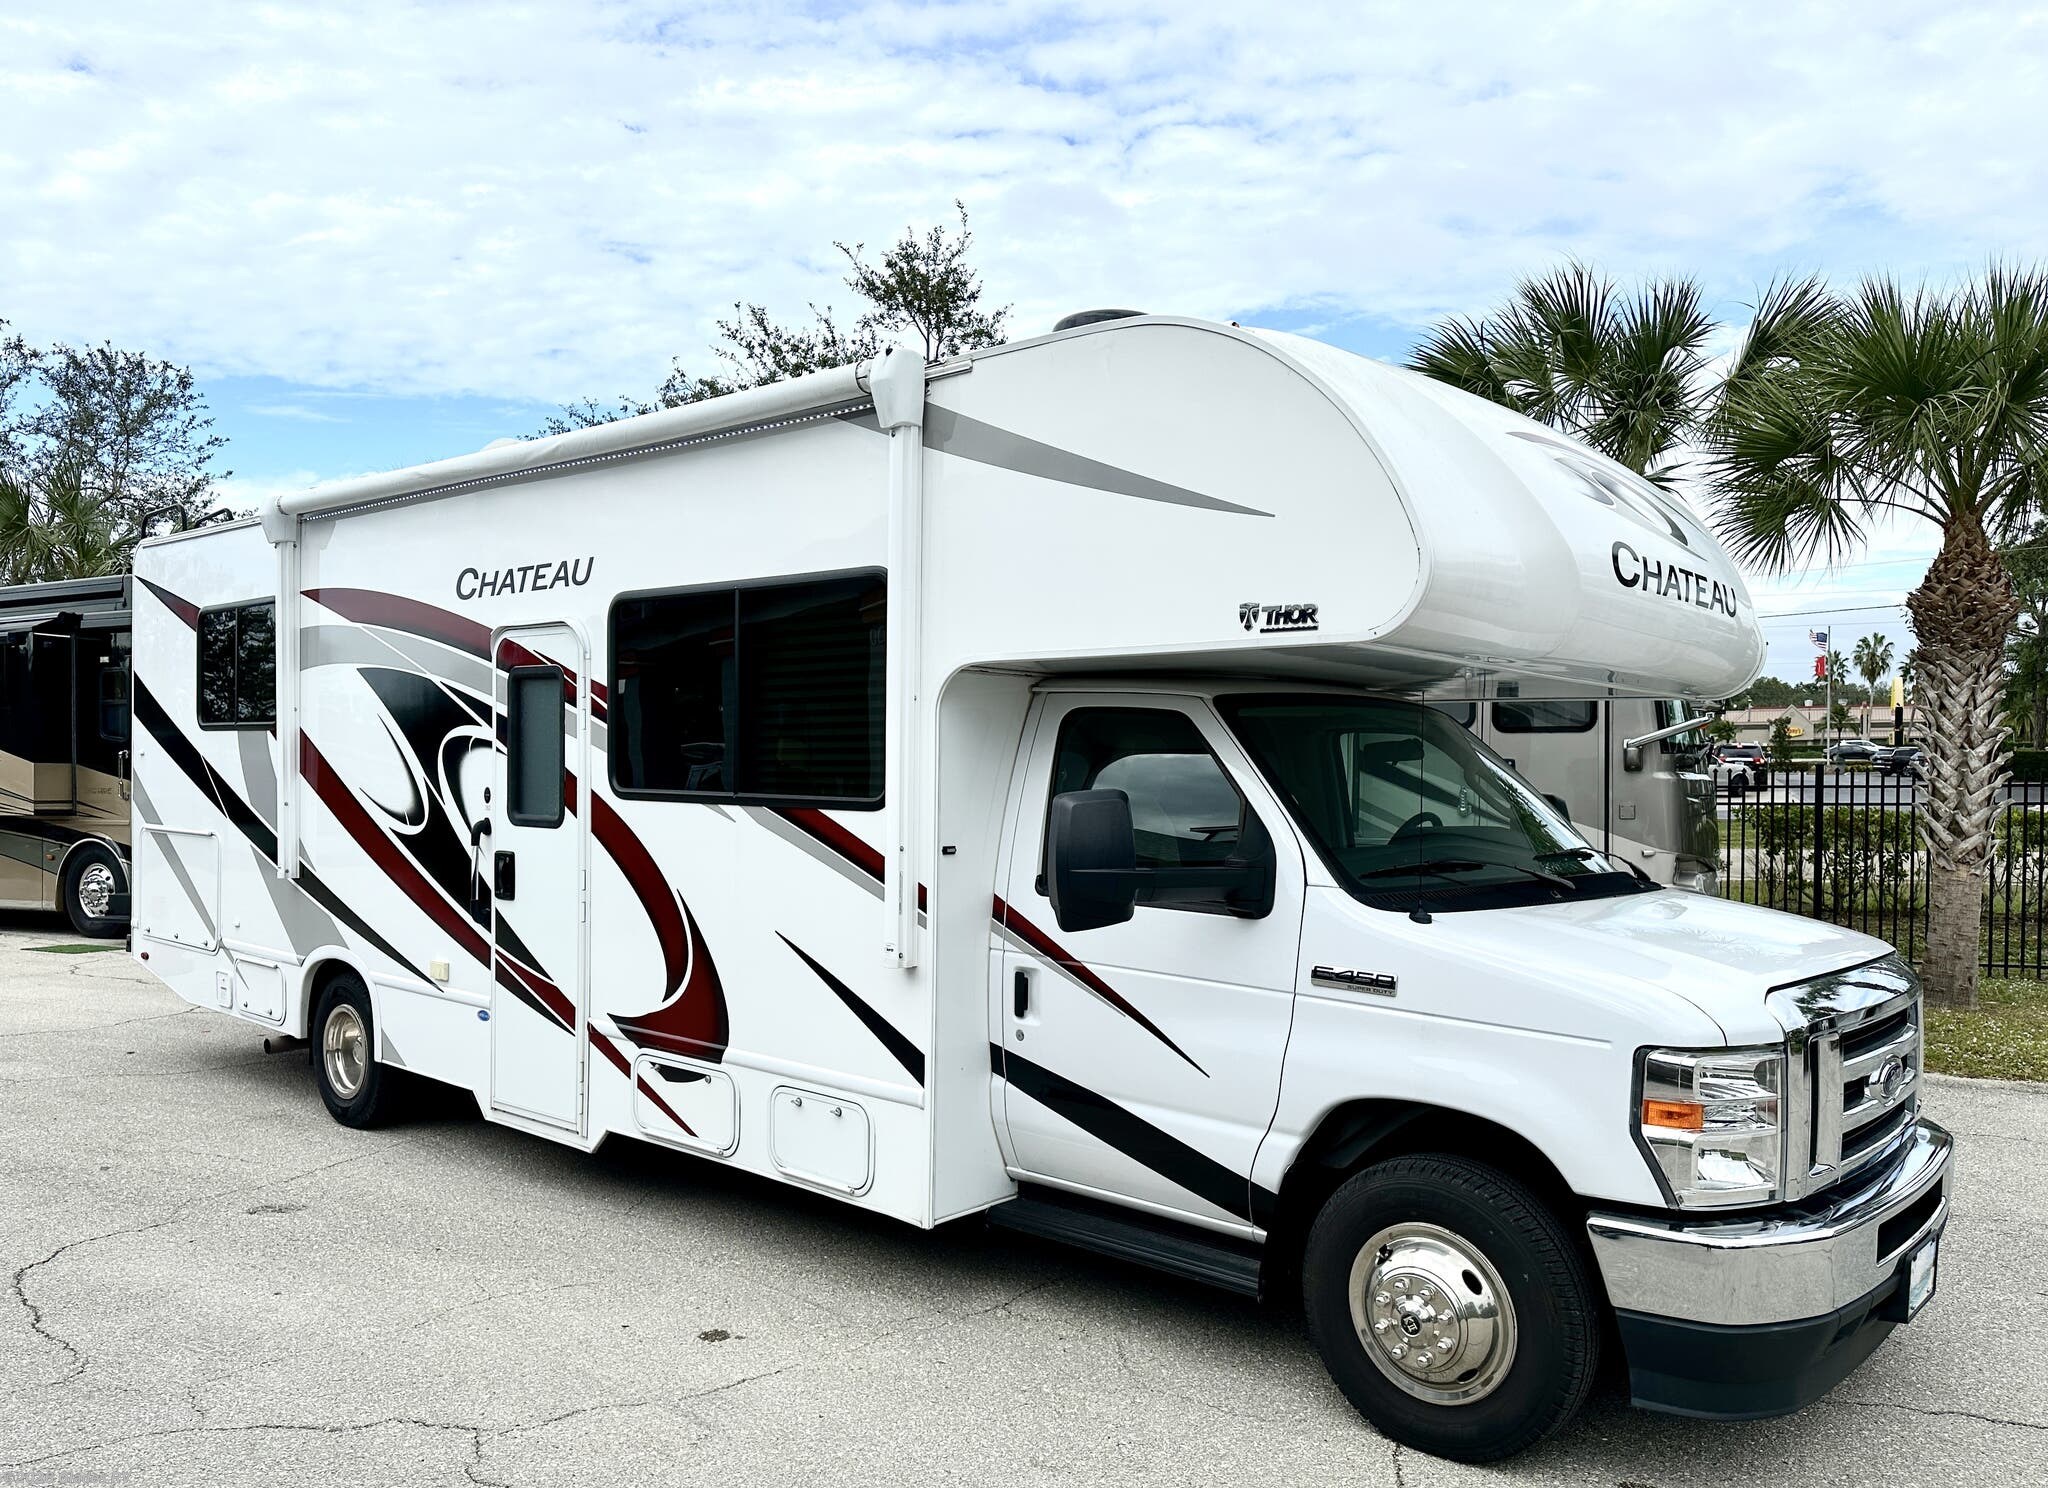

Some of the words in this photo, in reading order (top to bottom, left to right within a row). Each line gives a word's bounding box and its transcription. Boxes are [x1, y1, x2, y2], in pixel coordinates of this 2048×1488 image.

[456, 556, 594, 600] CHATEAU
[1612, 541, 1737, 618] CHATEAU
[1261, 604, 1319, 625] THOR
